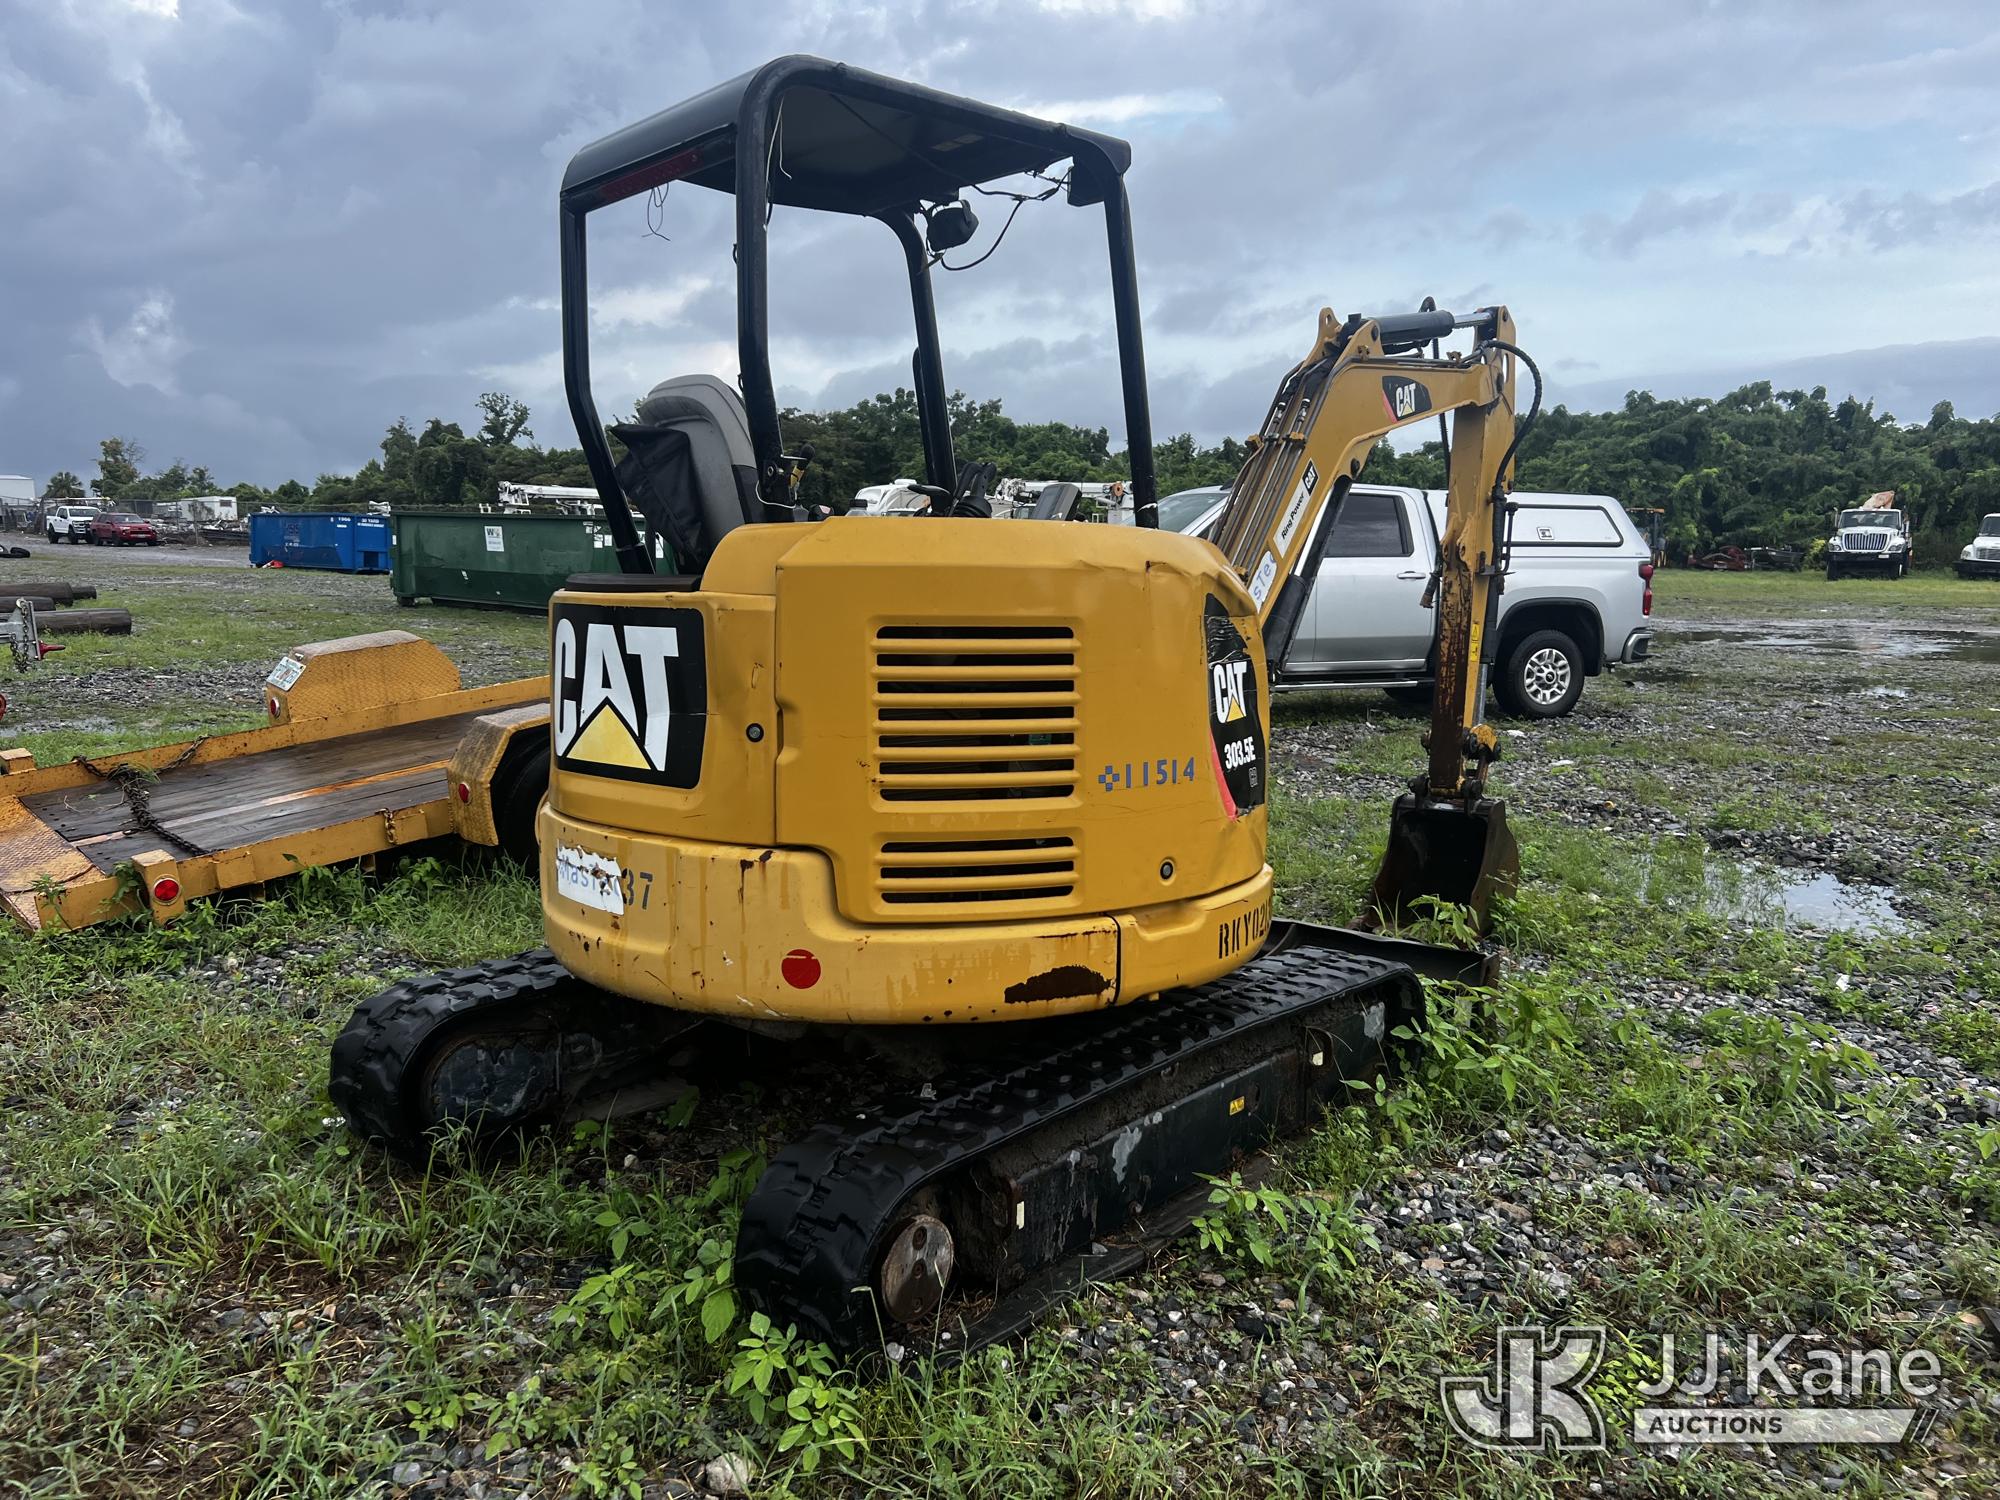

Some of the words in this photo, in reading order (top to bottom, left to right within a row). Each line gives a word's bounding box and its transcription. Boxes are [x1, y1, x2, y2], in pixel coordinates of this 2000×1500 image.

[1396, 382, 1416, 418] CAT
[1281, 519, 1294, 540] Ring
[1290, 490, 1305, 521] Power
[555, 618, 680, 772] CAT
[1213, 661, 1247, 724] CAT
[1125, 757, 1195, 789] 11514
[1224, 736, 1257, 769] 303.5E
